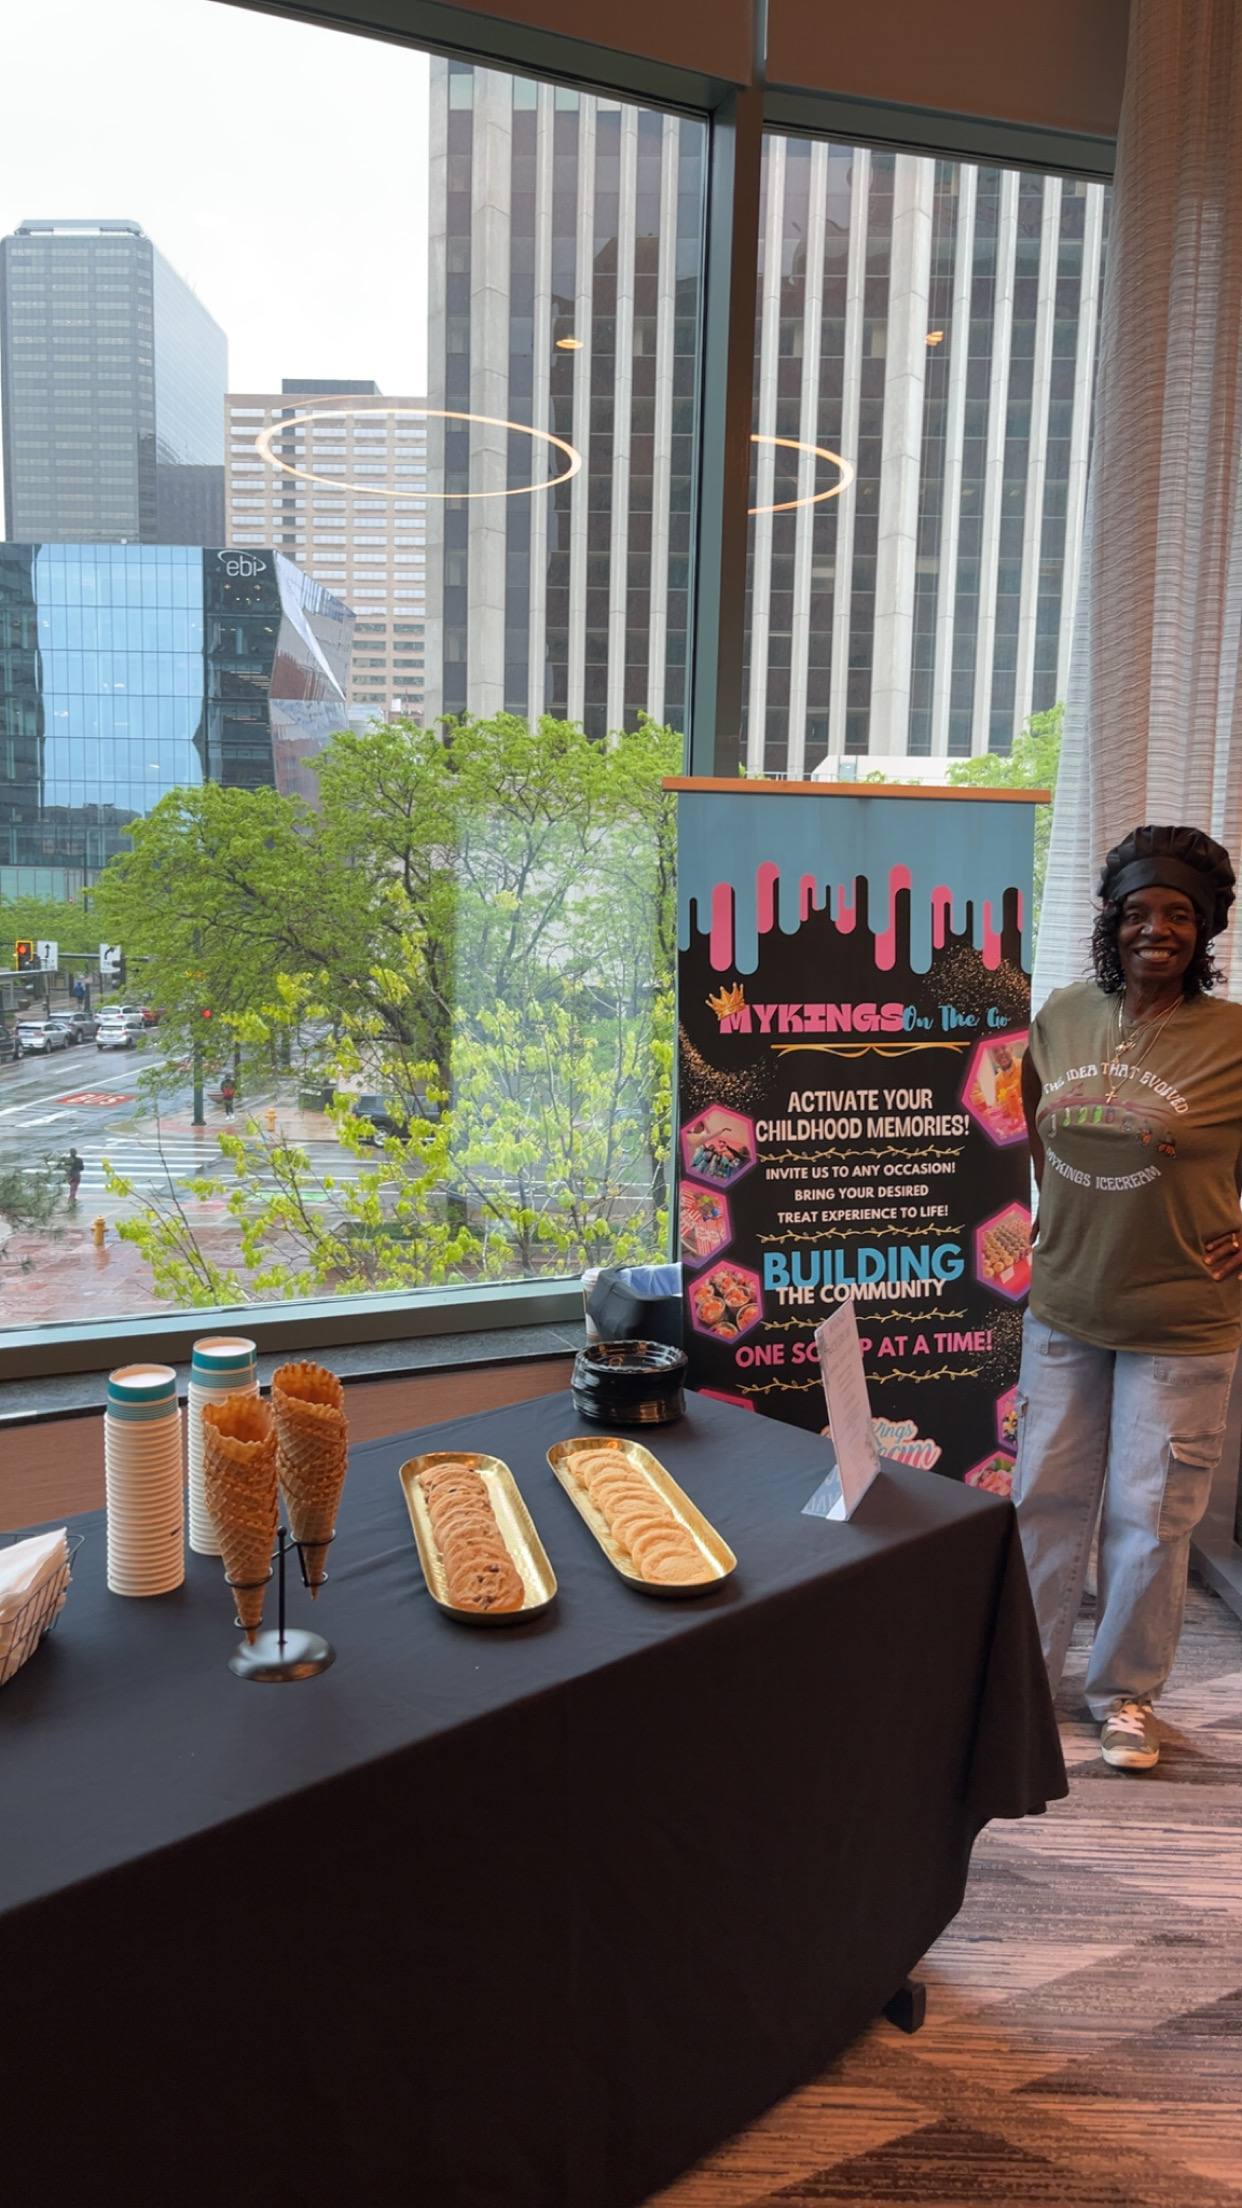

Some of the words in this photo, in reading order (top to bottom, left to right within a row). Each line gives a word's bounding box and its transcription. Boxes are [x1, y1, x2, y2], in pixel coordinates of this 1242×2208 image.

[226, 555, 257, 577] ebi
[719, 1003, 905, 1034] MYKINGS
[902, 1005, 933, 1031] On
[938, 1005, 979, 1031] The
[986, 1005, 1011, 1029] Go
[787, 1089, 879, 1113] ACTIVATE
[883, 1088, 933, 1110] YOUR
[1043, 1076, 1065, 1094] THE
[1066, 1064, 1098, 1081] IDEA
[1101, 1062, 1140, 1079] THAT
[1139, 1071, 1189, 1113] EVOLVED
[755, 1117, 862, 1142] CHILDHOOD
[867, 1114, 970, 1138] MEMORIES!
[766, 1167, 808, 1180] INVITE
[812, 1166, 828, 1179] US
[832, 1166, 849, 1178] TO
[852, 1165, 881, 1177] ANY
[883, 1162, 956, 1175] OCCASION!
[1046, 1147, 1091, 1187] MYKINGS
[1095, 1165, 1162, 1191] ICECREAM
[794, 1188, 835, 1201] BRING
[839, 1186, 874, 1199] YOUR
[878, 1184, 929, 1198] DESIRED
[777, 1211, 819, 1223] TREAT
[821, 1208, 897, 1222] EXPERIENCE
[900, 1207, 917, 1219] TO
[920, 1205, 948, 1217] LIFE!
[764, 1243, 965, 1290] BUILDING
[776, 1286, 815, 1305] THE
[820, 1278, 946, 1303] COMMUNITY
[735, 1344, 785, 1368] ONE
[791, 1340, 872, 1364] SCP
[877, 1335, 908, 1358] AT
[912, 1334, 930, 1356] A
[934, 1330, 993, 1353] TIME!
